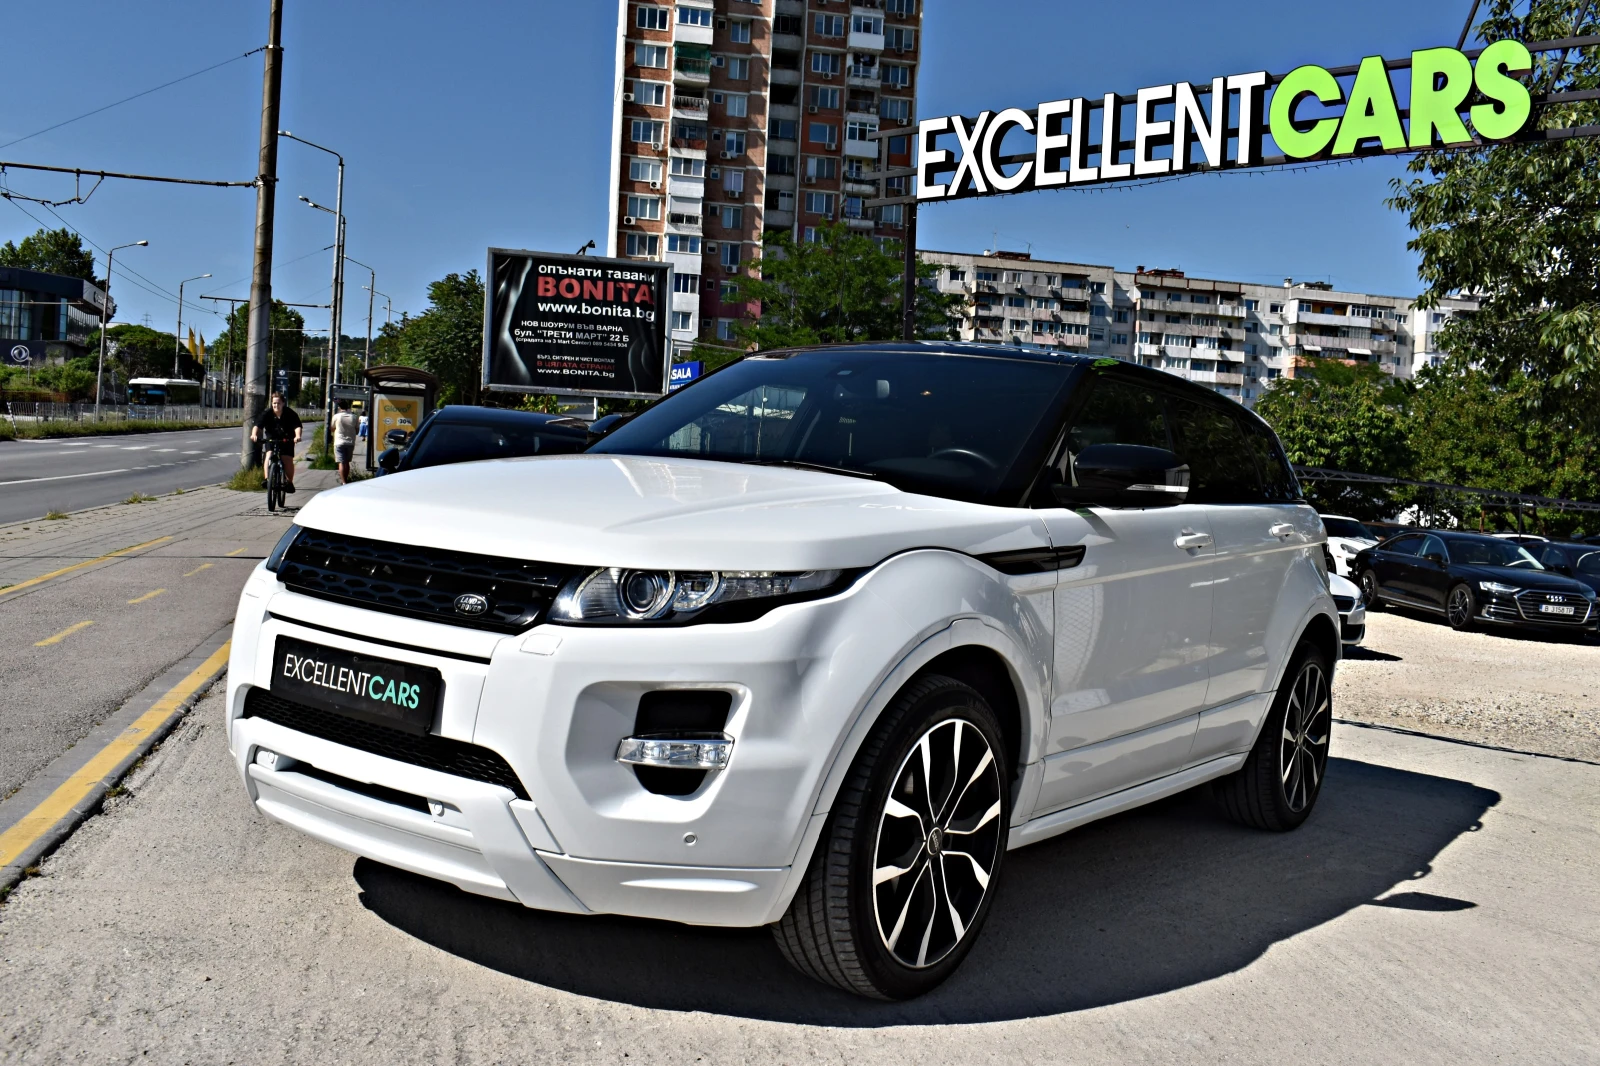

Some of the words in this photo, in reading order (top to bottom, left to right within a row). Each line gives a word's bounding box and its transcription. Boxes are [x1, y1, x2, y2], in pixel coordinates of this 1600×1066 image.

[538, 264, 601, 277] опънати
[606, 269, 654, 283] тавани
[537, 276, 654, 304] BONITA
[537, 302, 655, 322] www.bonita.bg
[540, 321, 575, 329] ШОУРУМ
[596, 324, 623, 332] ВАРНА
[514, 328, 535, 337] бул.
[609, 334, 620, 342] 22
[544, 361, 577, 369] ЦЯЛАТА
[537, 368, 615, 378] www.BONITA.bg
[460, 596, 478, 604] LAND
[460, 603, 482, 612] ROVER
